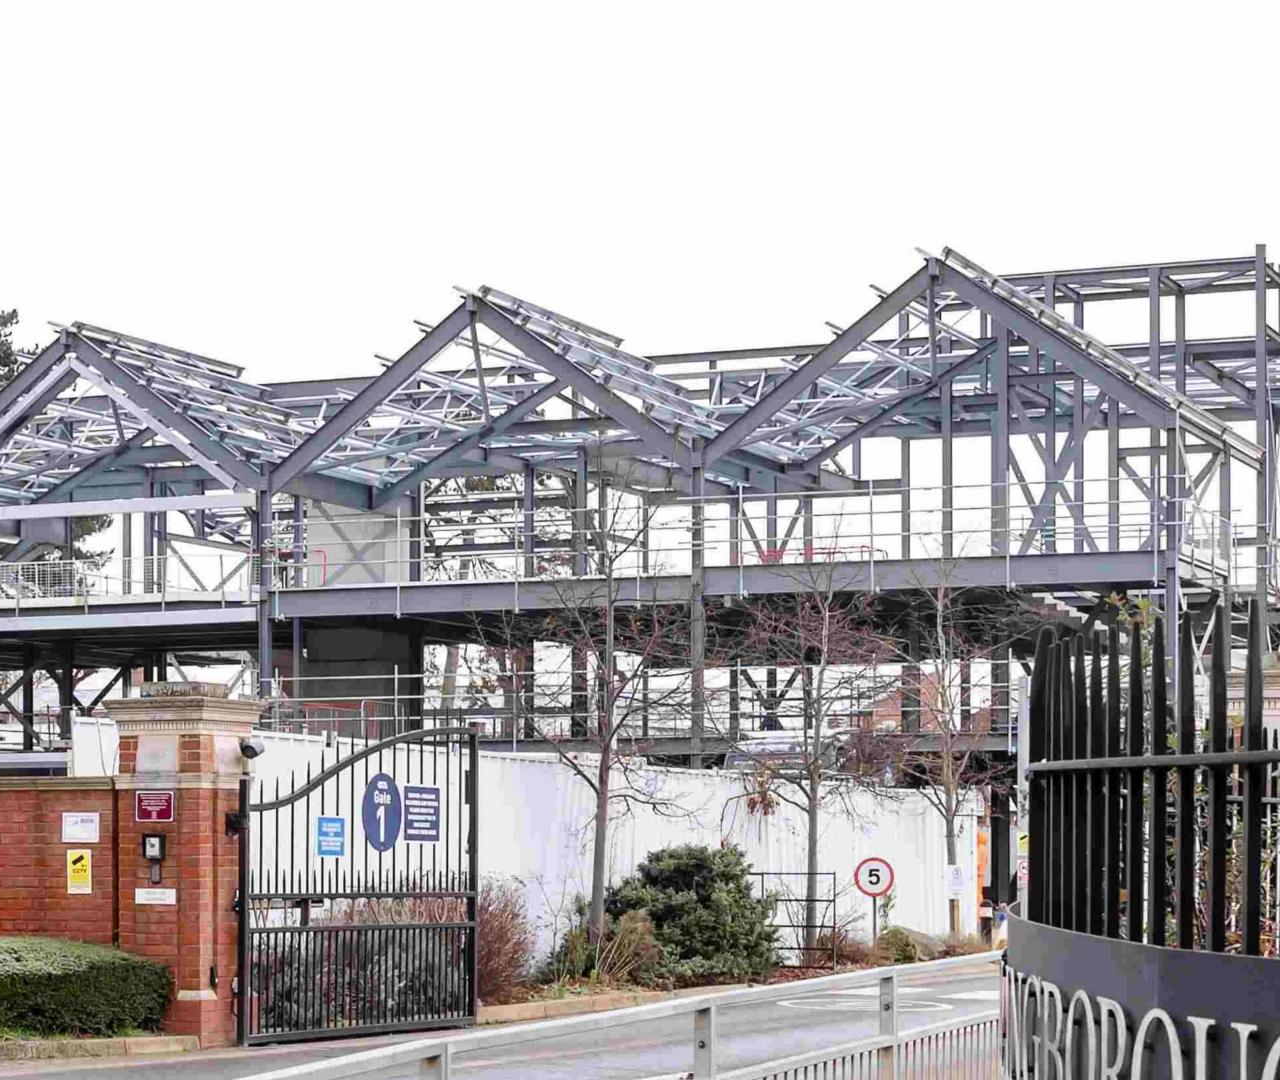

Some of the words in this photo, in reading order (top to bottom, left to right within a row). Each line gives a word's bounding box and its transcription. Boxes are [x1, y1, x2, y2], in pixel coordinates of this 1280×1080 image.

[373, 790, 391, 804] Gate
[376, 805, 385, 842] 1
[868, 868, 881, 885] 5
